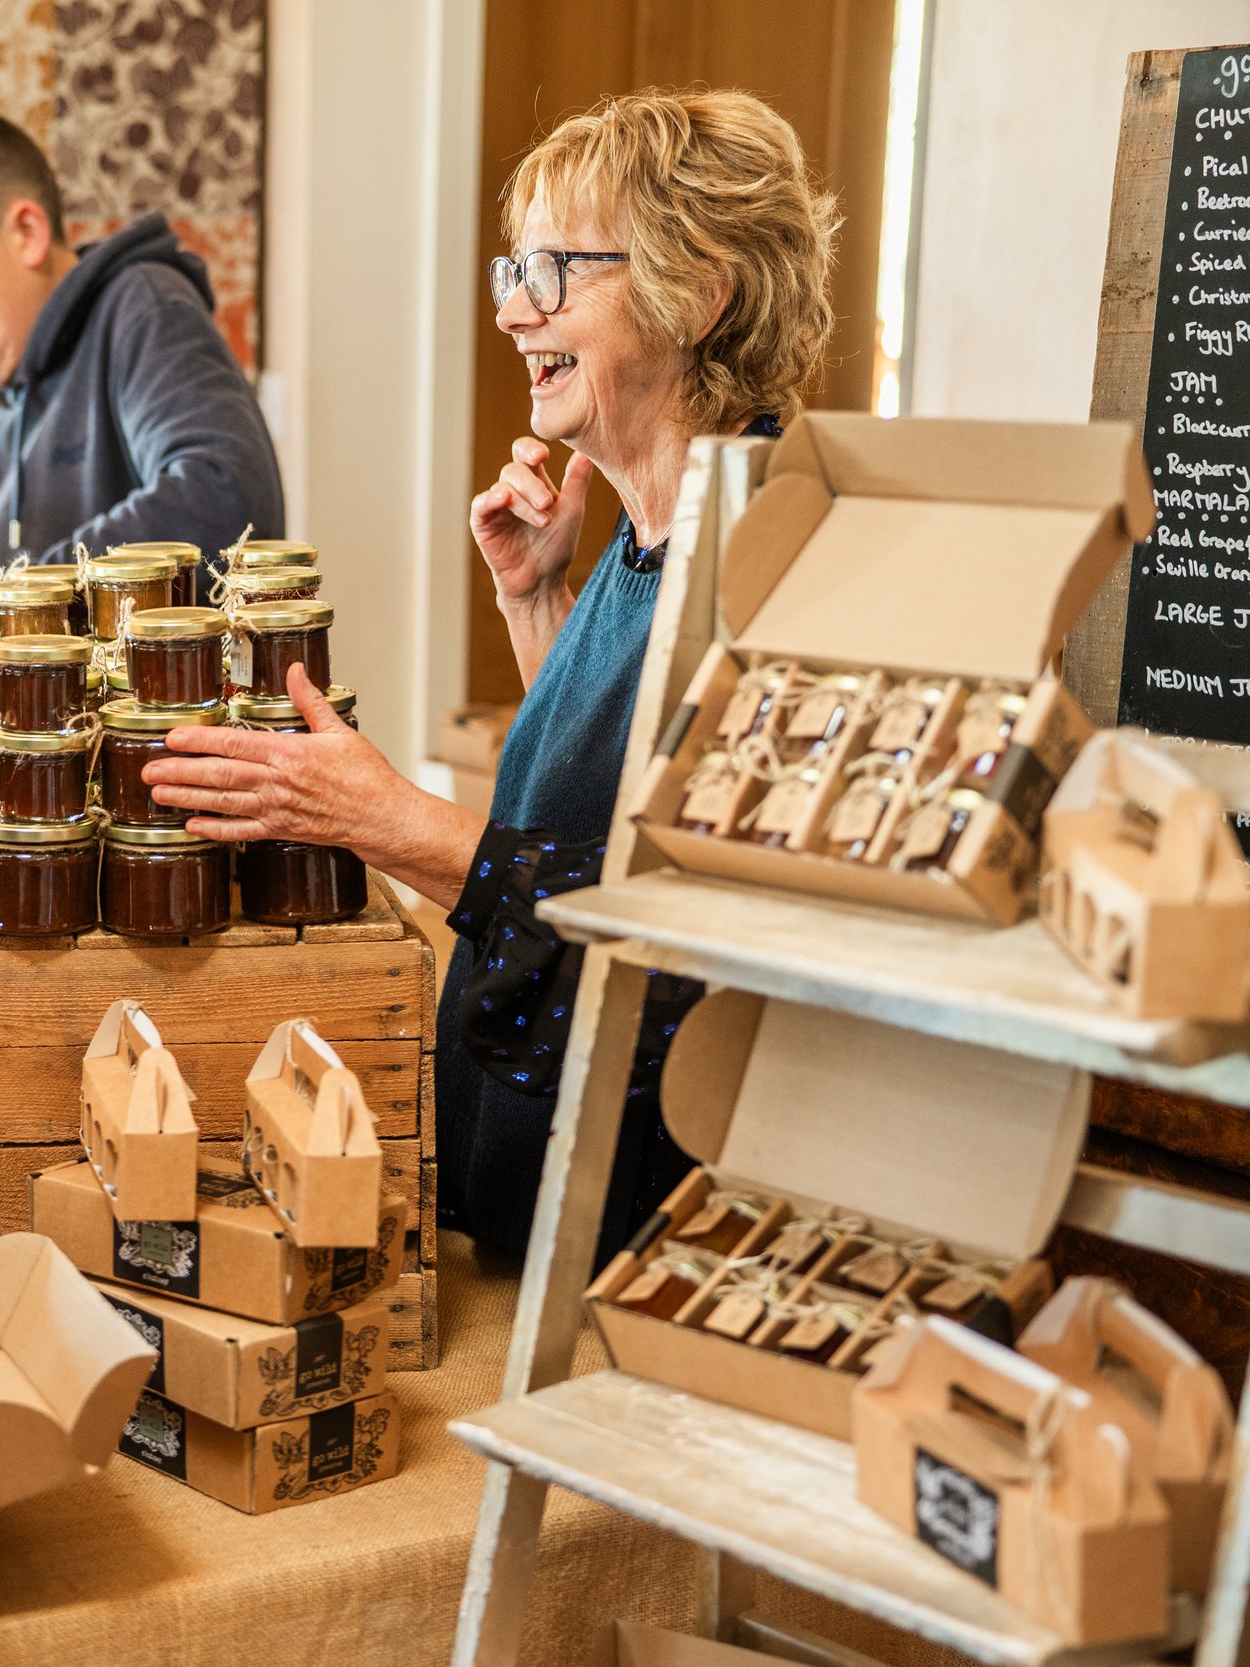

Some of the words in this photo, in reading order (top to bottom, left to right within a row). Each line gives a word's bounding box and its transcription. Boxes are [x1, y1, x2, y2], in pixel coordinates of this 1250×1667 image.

[1189, 251, 1247, 276] Spiced
[1185, 321, 1233, 357] Figgy
[1170, 371, 1218, 394] JAM
[1166, 452, 1250, 493] Raspberry
[1157, 525, 1193, 548] Red
[1156, 553, 1209, 578] Seville
[1154, 600, 1225, 627] LARGE
[1146, 665, 1223, 698] MEDIUM
[1229, 678, 1250, 697] J
